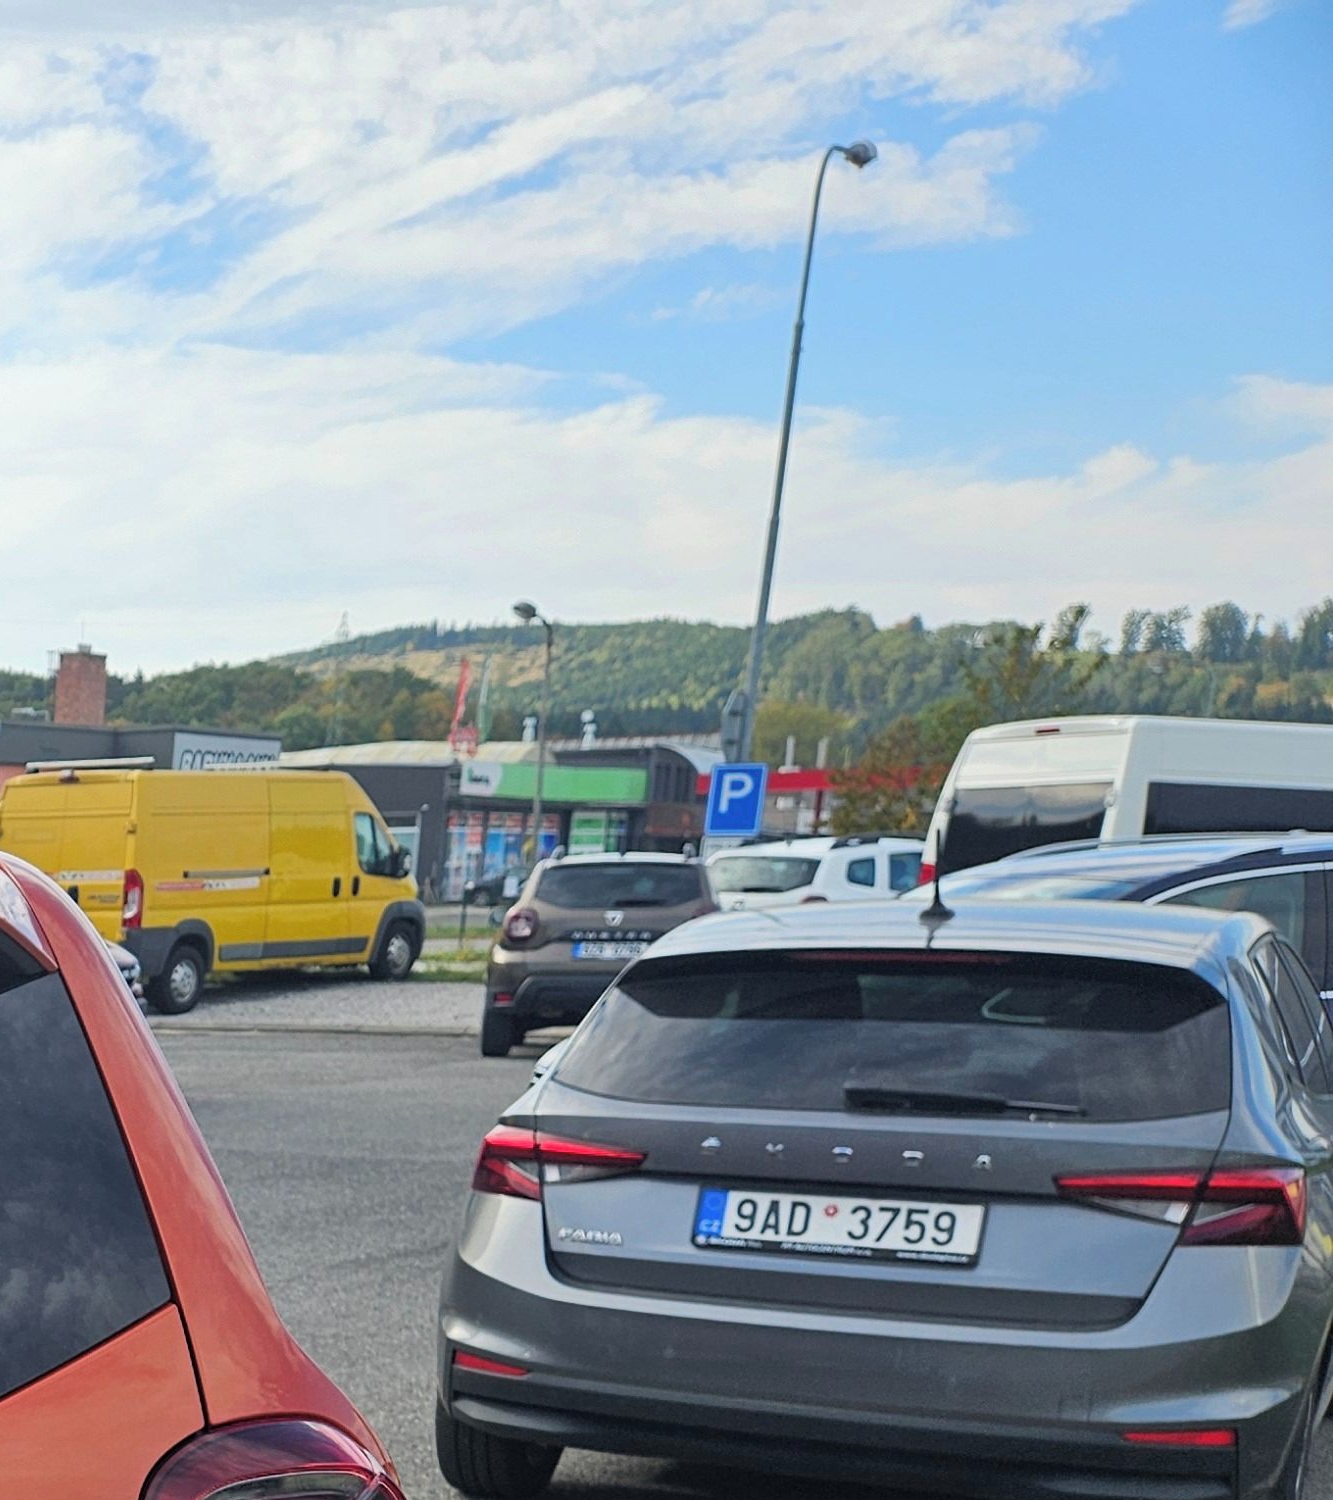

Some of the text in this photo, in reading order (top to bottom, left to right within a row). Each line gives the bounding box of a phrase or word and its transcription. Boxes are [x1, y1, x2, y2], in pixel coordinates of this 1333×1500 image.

[718, 772, 754, 814] P
[699, 1219, 722, 1233] CZ
[734, 1198, 957, 1246] 9AD 3759
